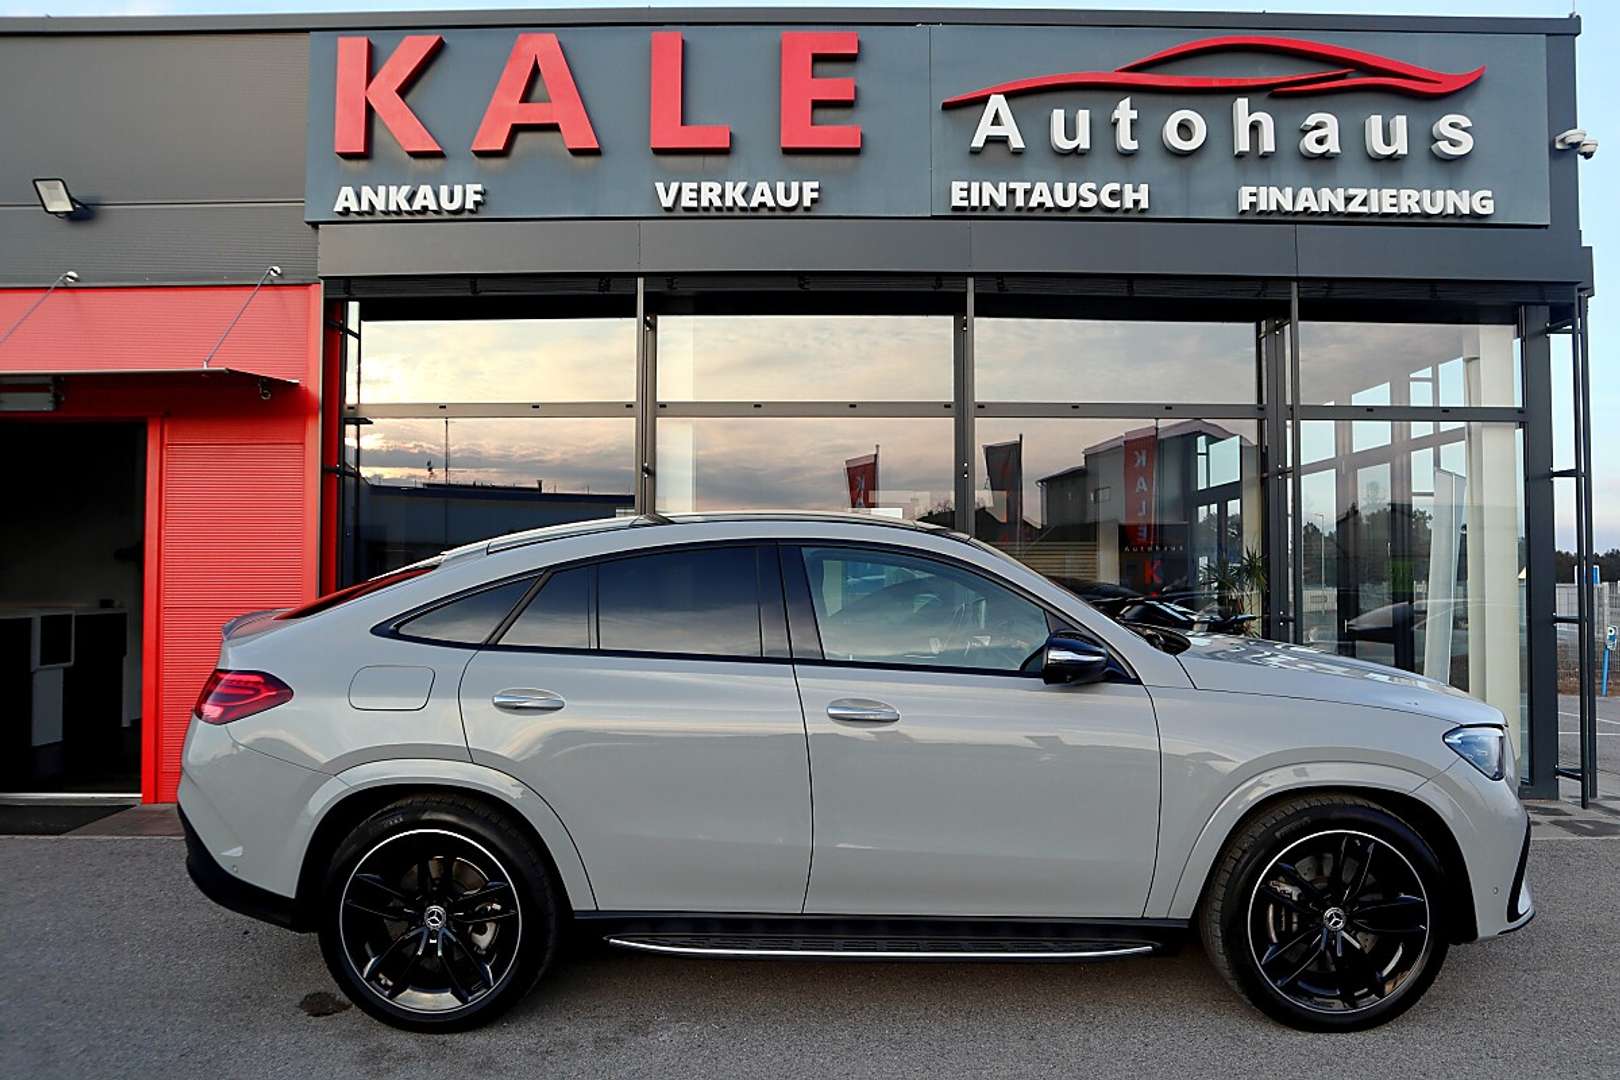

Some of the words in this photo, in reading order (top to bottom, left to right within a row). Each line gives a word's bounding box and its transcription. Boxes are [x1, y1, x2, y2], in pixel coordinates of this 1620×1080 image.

[334, 31, 862, 156] KALE
[969, 94, 1475, 159] Autohaus
[334, 183, 485, 214] ANKAUF
[655, 180, 821, 210] VERKAUF
[950, 180, 1150, 211] EINTAUSCH
[1238, 186, 1495, 217] FINANZIERUNG
